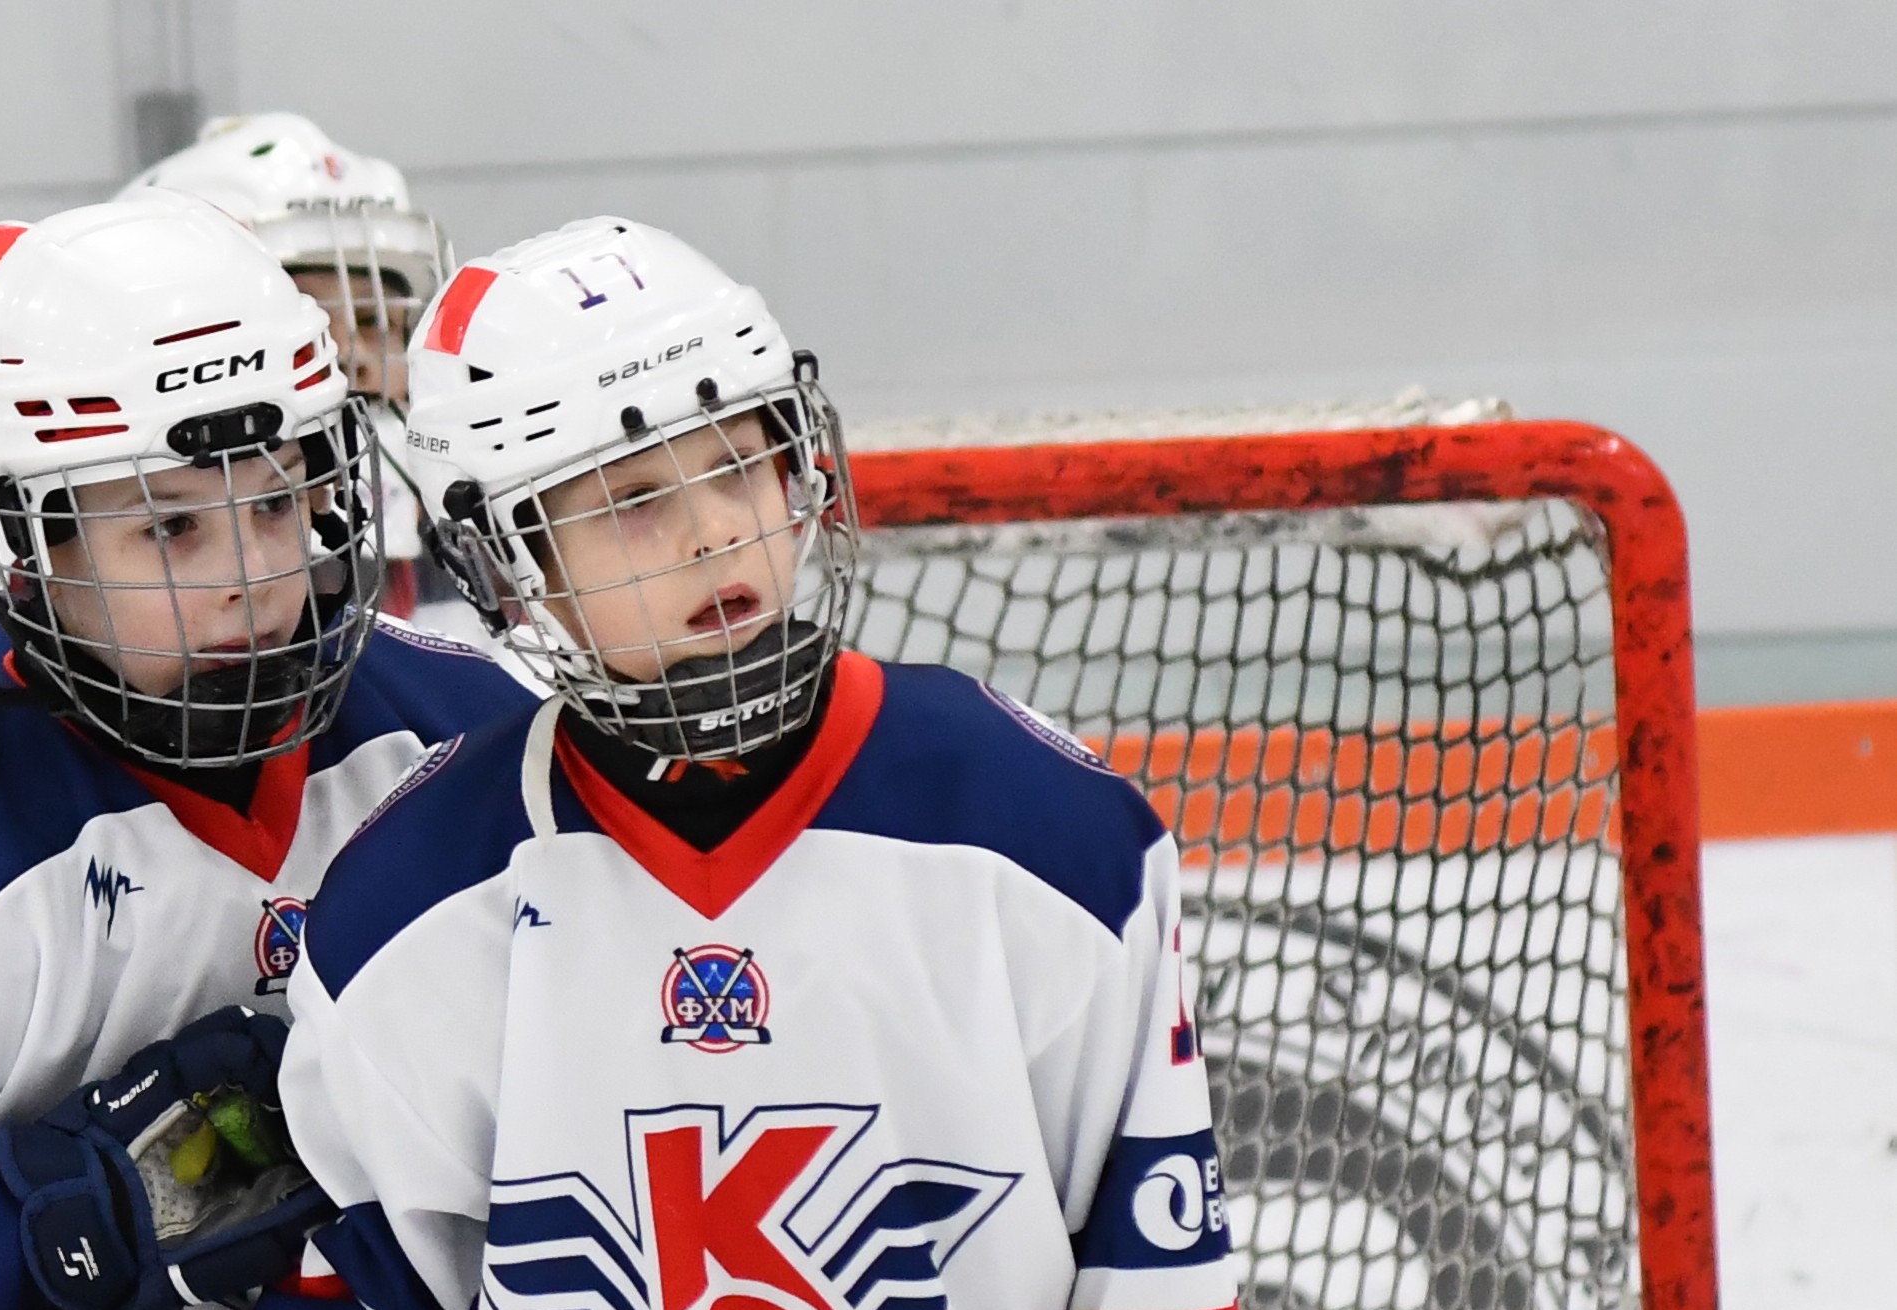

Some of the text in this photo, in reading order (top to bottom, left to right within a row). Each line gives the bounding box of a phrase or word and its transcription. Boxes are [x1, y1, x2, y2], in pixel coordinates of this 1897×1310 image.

[558, 252, 646, 310] 17
[156, 350, 266, 393] CCM
[598, 337, 704, 387] BAUER
[406, 429, 450, 455] BAUER
[675, 995, 756, 1025] ФХМ
